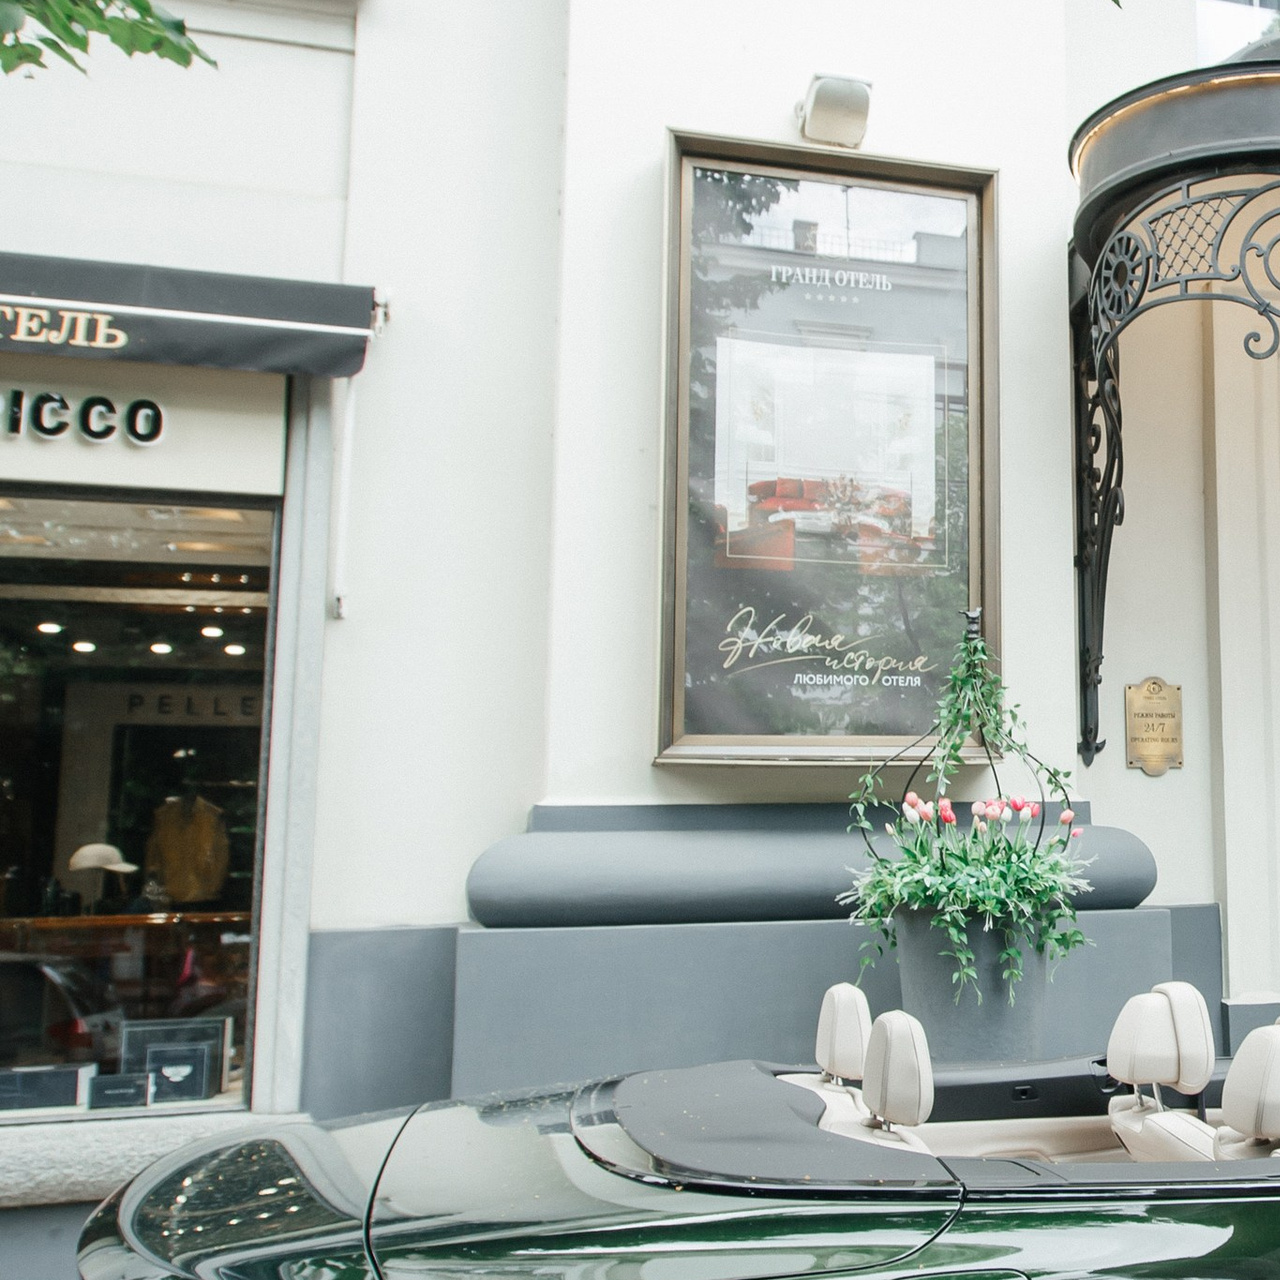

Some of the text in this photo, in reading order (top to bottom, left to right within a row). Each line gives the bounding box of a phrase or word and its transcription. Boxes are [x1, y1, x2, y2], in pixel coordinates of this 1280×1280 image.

[770, 264, 893, 292] ГРАНД ОТЕЛЬ
[822, 649, 939, 685] история
[793, 672, 922, 688] ЛЮБИМОГО ОТЕЛЯ
[1143, 722, 1166, 733] 24/7
